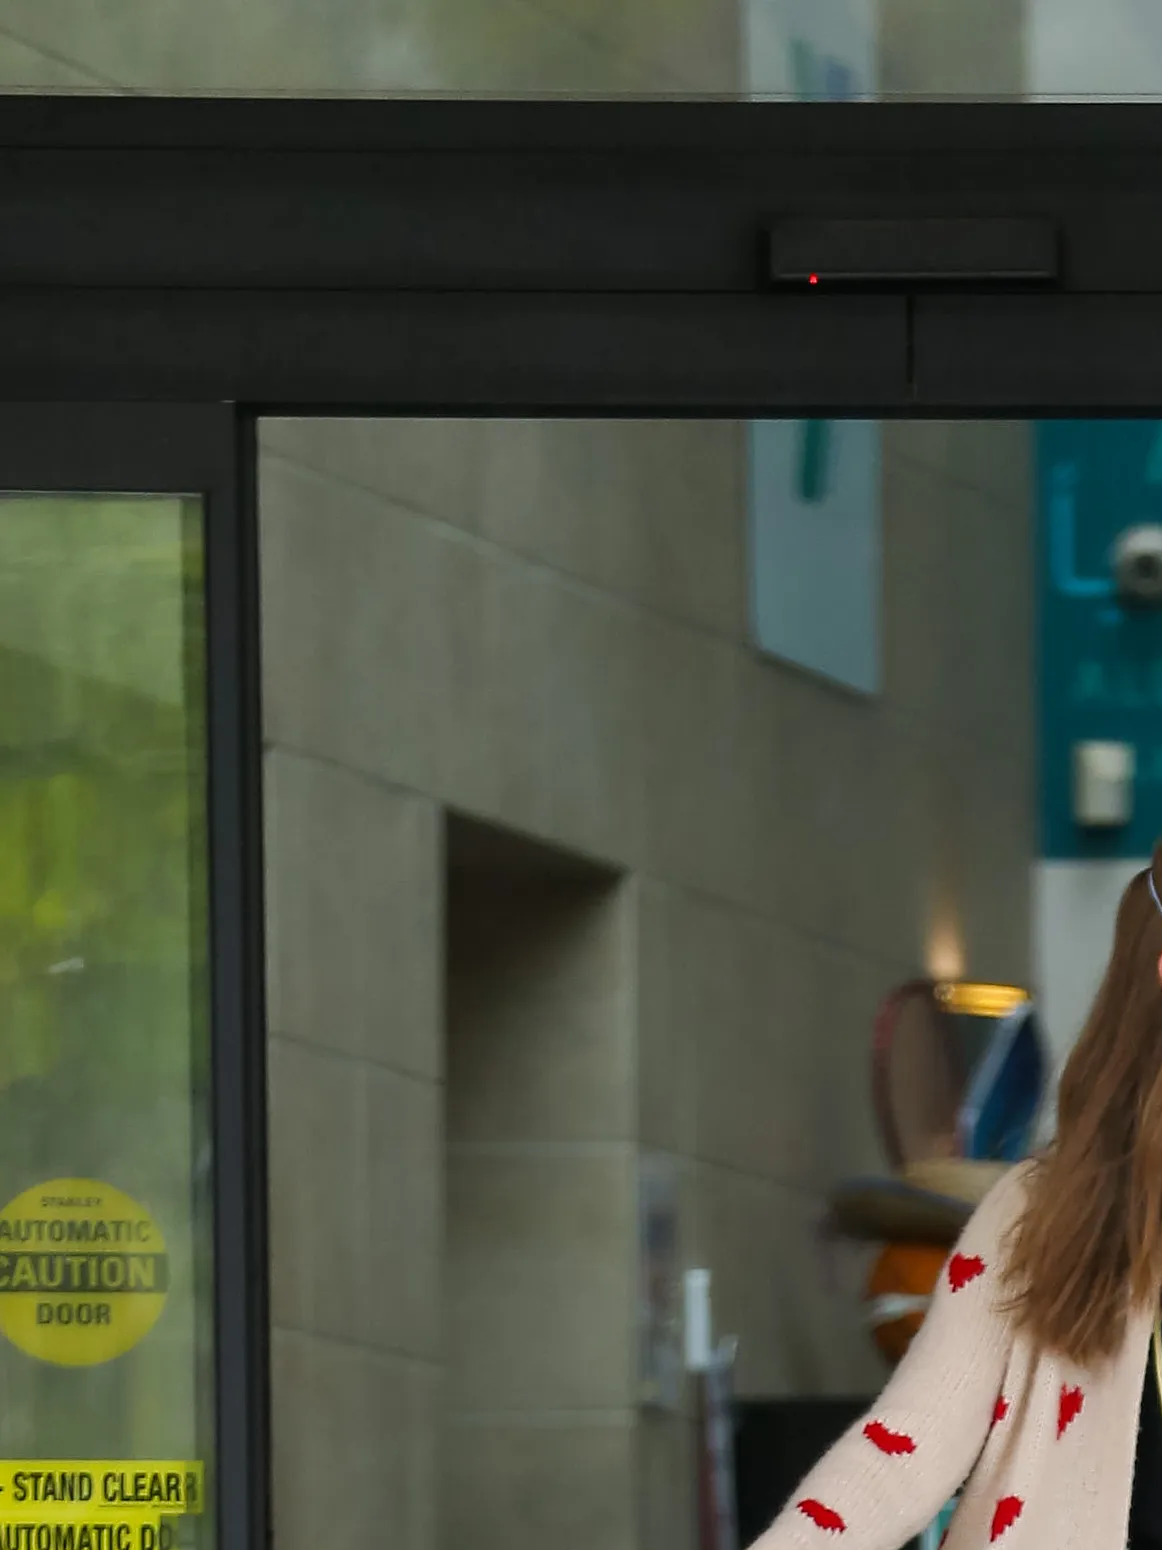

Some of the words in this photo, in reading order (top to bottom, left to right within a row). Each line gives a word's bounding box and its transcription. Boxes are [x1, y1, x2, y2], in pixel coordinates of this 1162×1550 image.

[0, 1220, 151, 1243] AUTOMATIC
[37, 1302, 112, 1325] DOOR
[13, 1471, 93, 1502] STAND
